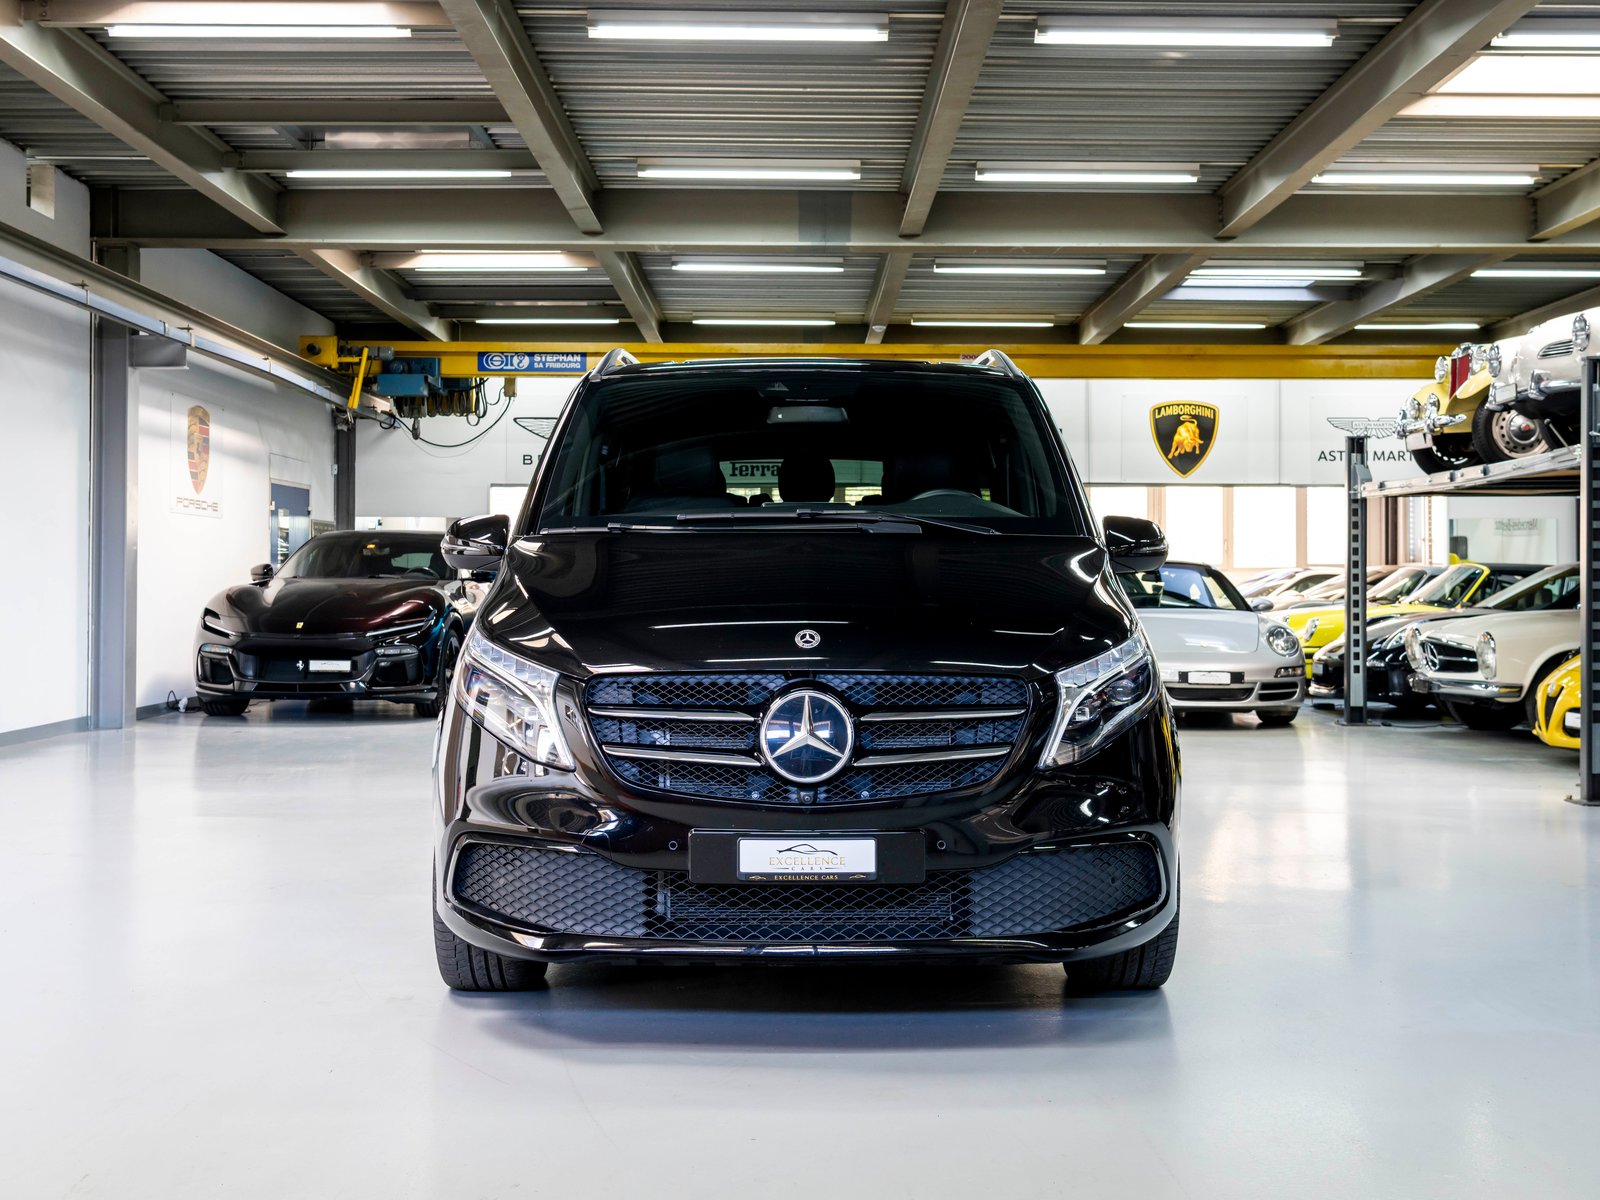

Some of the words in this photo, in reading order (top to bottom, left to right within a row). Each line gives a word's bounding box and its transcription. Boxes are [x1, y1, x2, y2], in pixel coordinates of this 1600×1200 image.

[534, 354, 581, 362] STEPHAN
[1155, 405, 1214, 419] LAMBORGHINI
[1317, 450, 1346, 462] AST
[1373, 450, 1414, 462] MART
[729, 461, 780, 477] Ferra
[769, 856, 846, 866] EXCELLENCE
